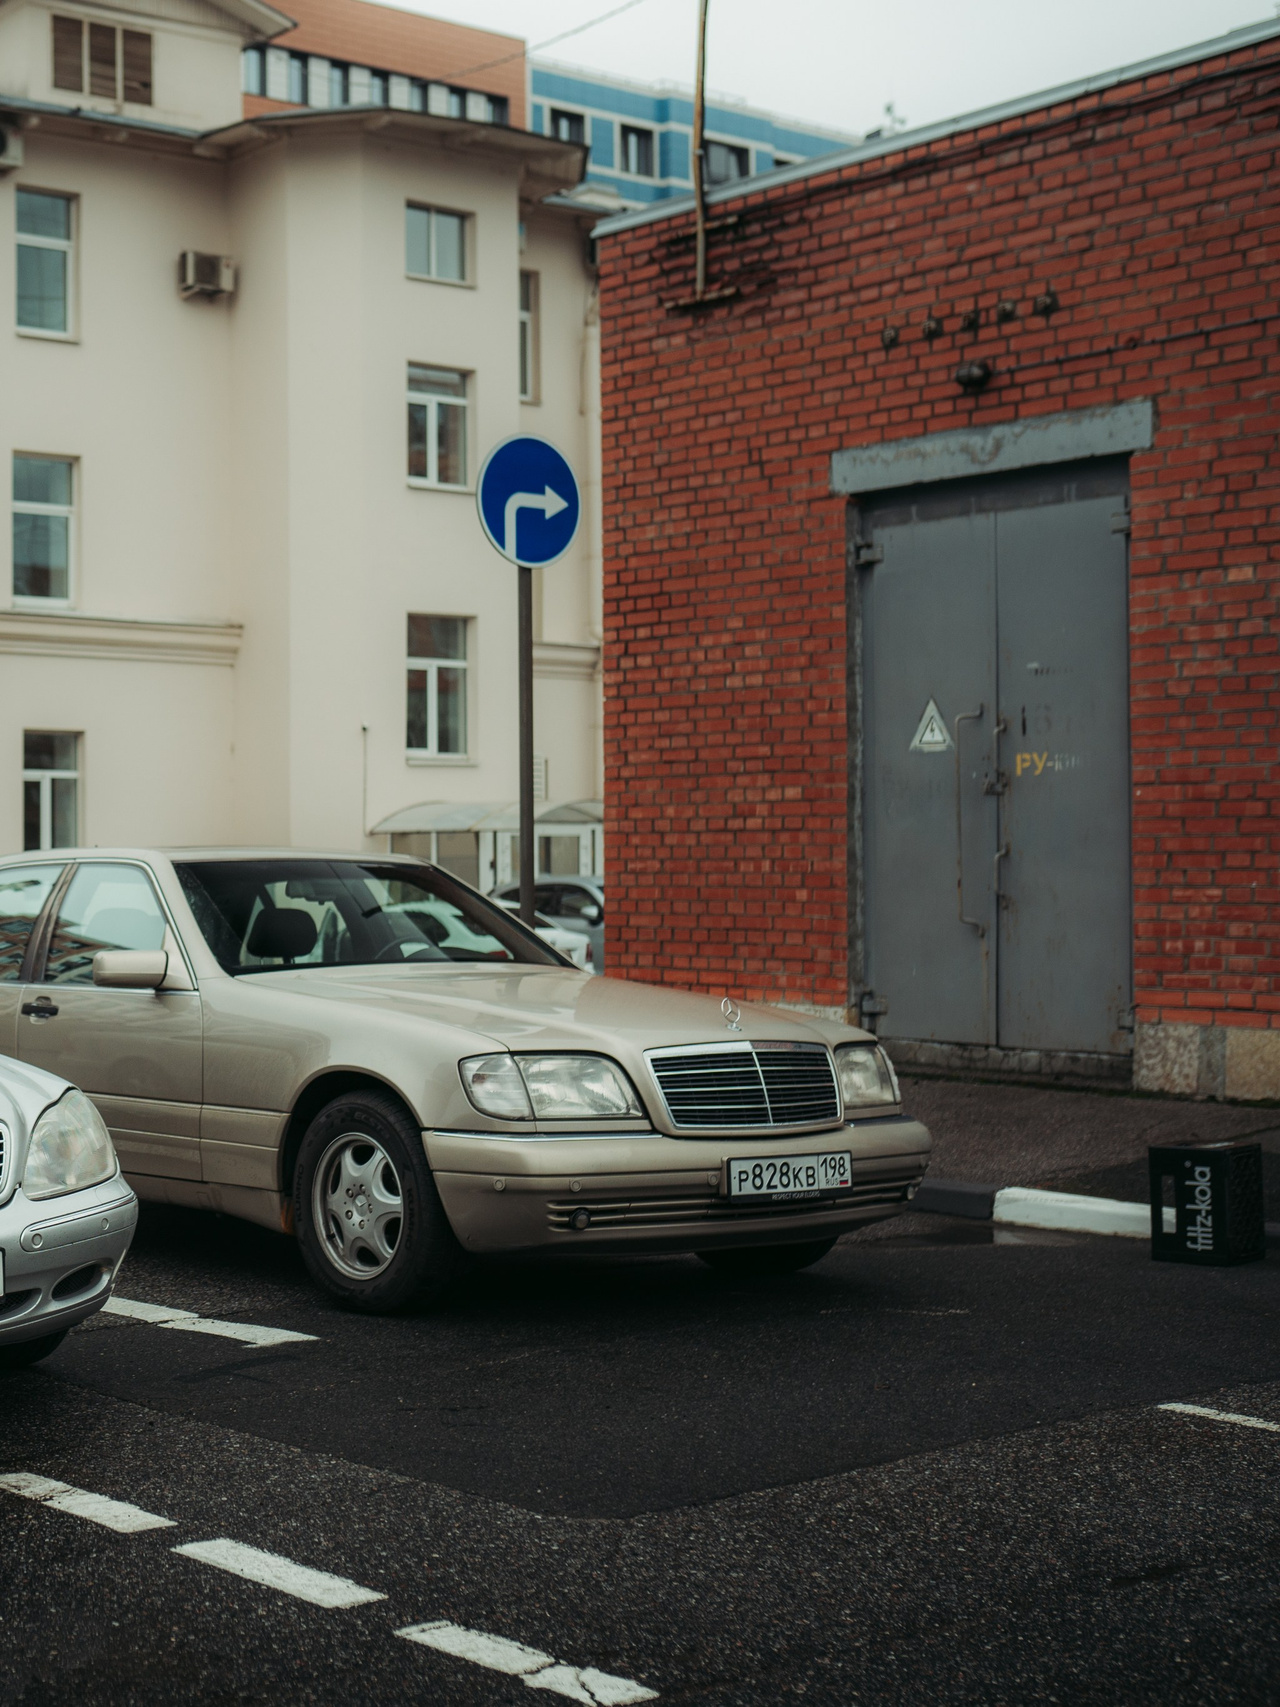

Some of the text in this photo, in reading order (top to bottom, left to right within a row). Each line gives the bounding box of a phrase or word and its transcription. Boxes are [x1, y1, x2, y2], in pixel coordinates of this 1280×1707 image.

[738, 1156, 846, 1192] Р828КВ 198
[825, 1178, 839, 1186] RUS
[1184, 1166, 1213, 1251] fritz-kola
